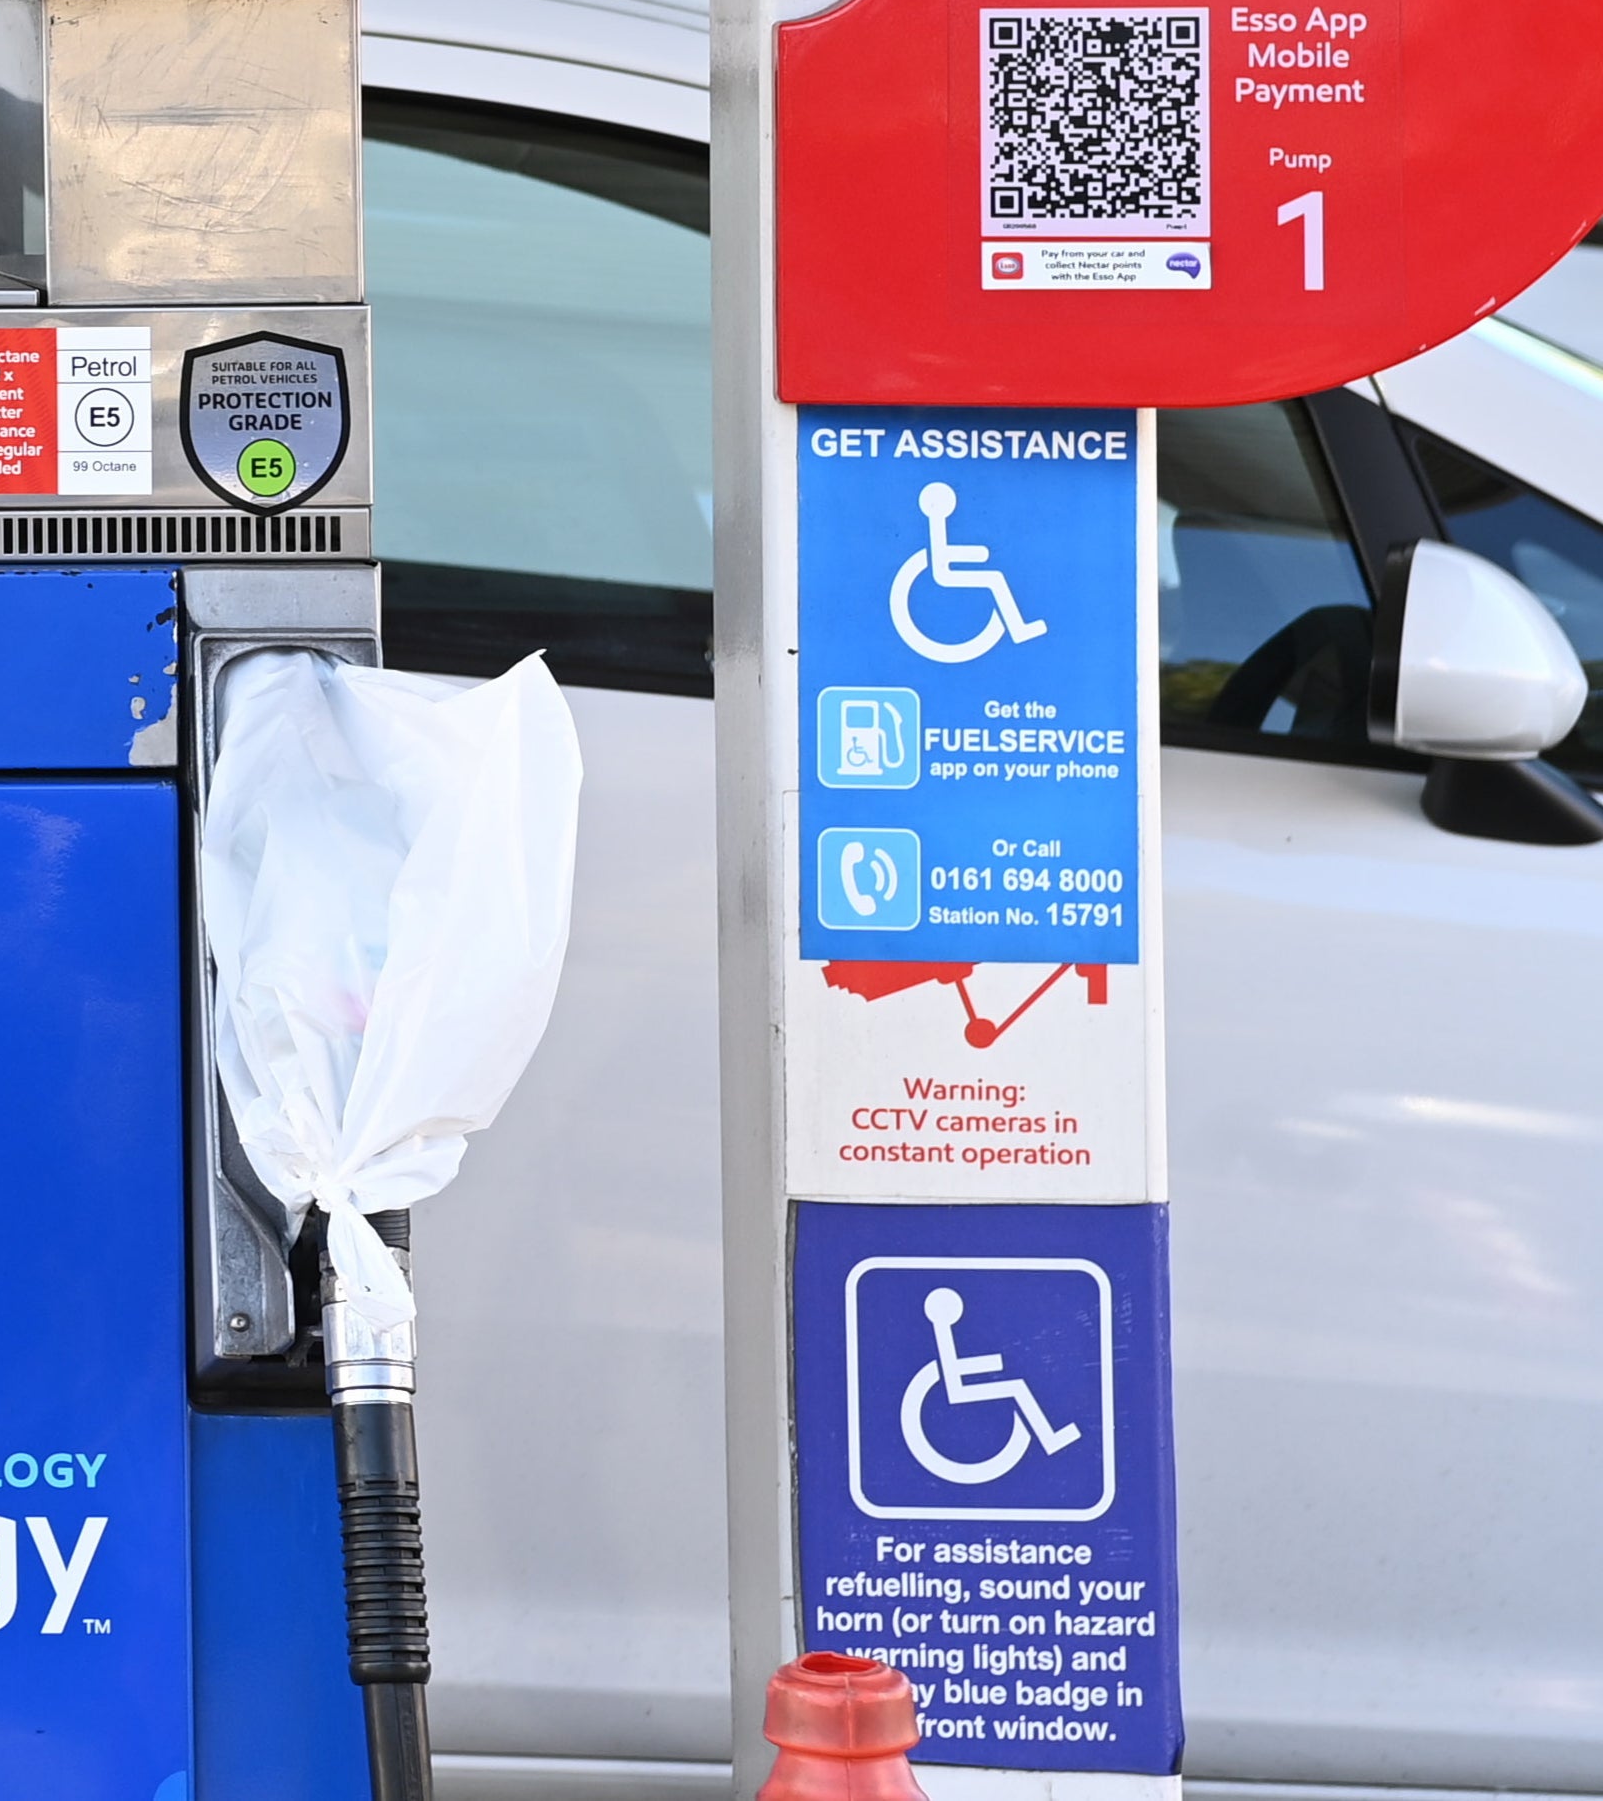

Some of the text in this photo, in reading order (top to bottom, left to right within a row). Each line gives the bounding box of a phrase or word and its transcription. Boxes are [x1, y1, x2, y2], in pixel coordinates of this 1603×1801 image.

[1231, 7, 1367, 39] Esso App
[1247, 41, 1350, 69] Mobile
[1234, 77, 1365, 110] Payment
[1269, 147, 1332, 174] Pump
[1277, 191, 1325, 291] 1
[70, 355, 138, 379] Petrol
[211, 360, 317, 373] SUITABLE FOR ALL
[211, 373, 318, 386] PETROL VEHICLES
[197, 391, 333, 411] PROTECTION
[89, 406, 120, 429] E5
[228, 412, 302, 433] GRADE
[811, 429, 1128, 460] GET ASSISTANCE
[73, 458, 136, 473] 99 Octane
[250, 455, 283, 480] E5
[984, 700, 1057, 719] Get the
[924, 728, 1125, 756] FUELSERVICE
[930, 866, 1123, 894] 0161 694 8000
[903, 1077, 1026, 1106] Warning:
[851, 1106, 1078, 1135] CCTV cameras in
[839, 1140, 1091, 1171] constant operation
[876, 1535, 1092, 1566] For assistance
